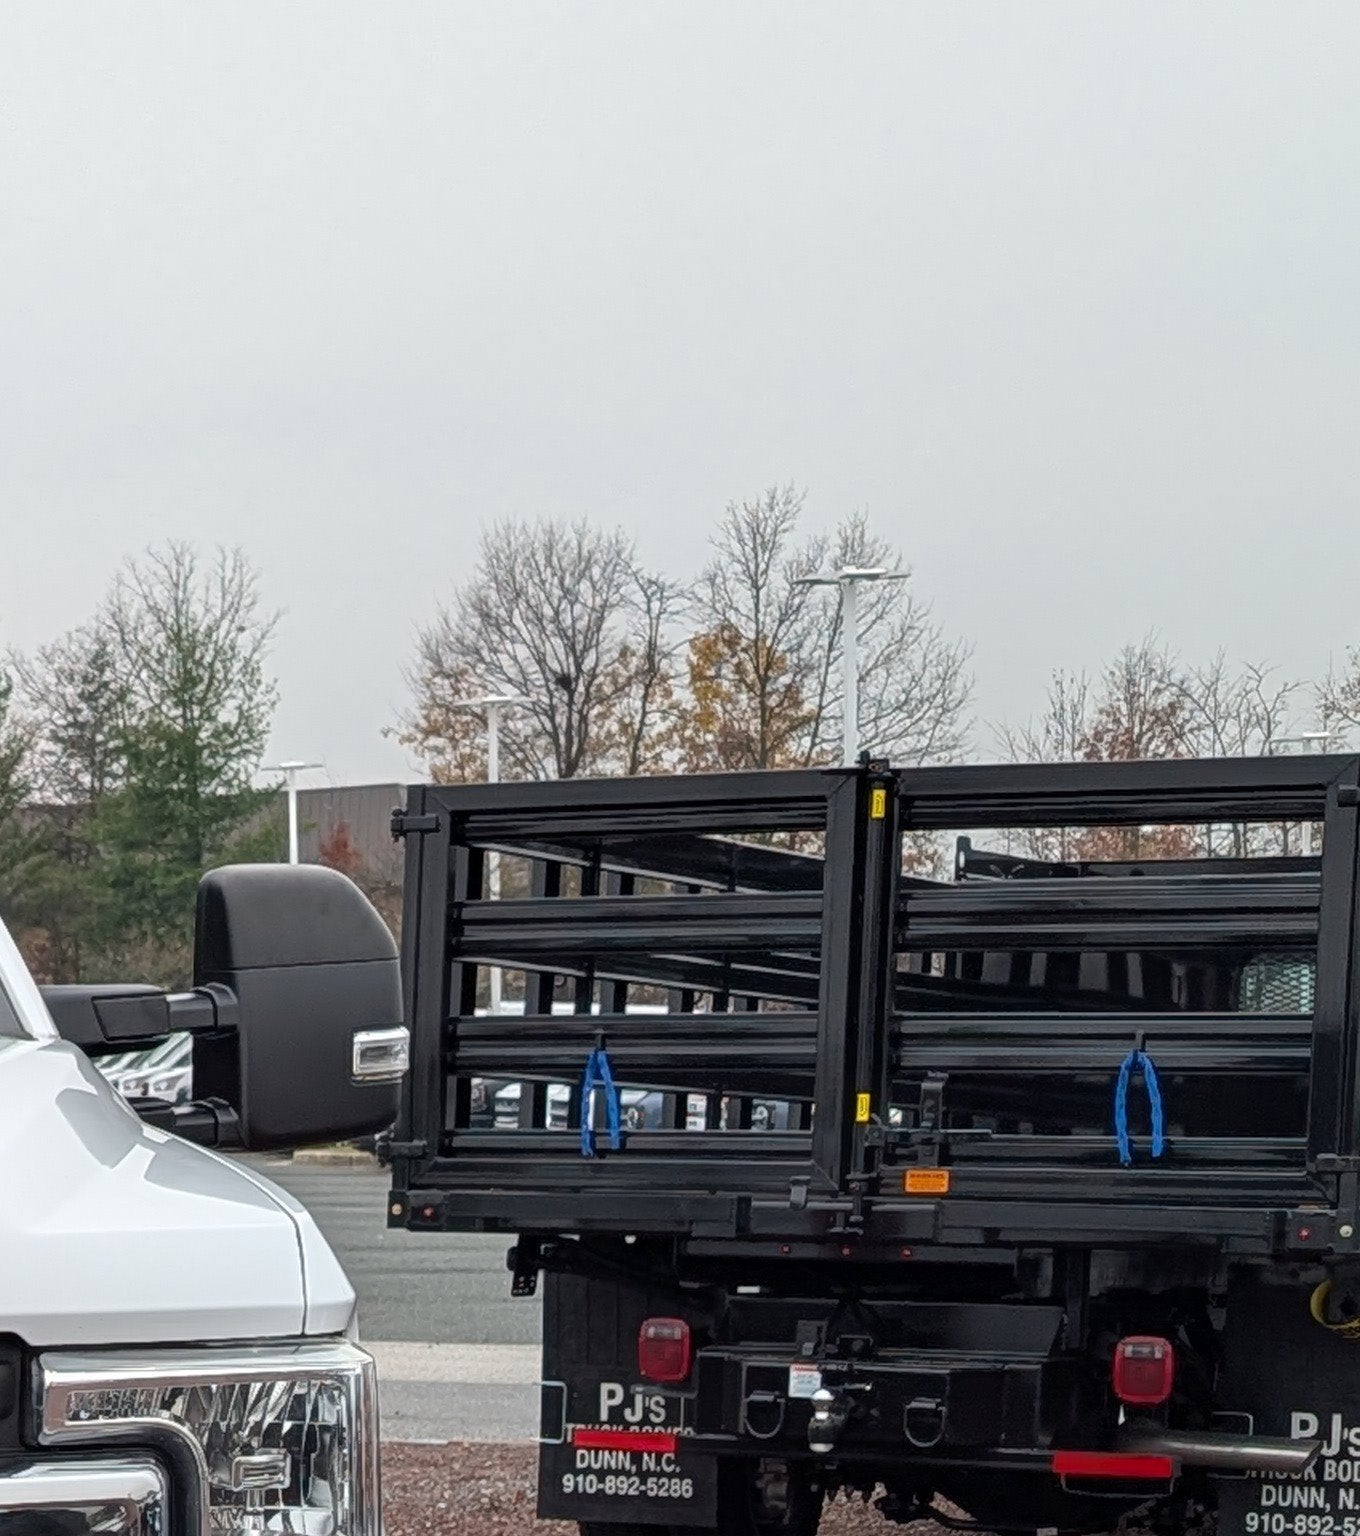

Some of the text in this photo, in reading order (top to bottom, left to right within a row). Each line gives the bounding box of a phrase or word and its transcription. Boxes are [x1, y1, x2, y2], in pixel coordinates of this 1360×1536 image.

[575, 1449, 681, 1474] DUNN, N.C.
[561, 1473, 694, 1499] 910-892-5286
[1260, 1484, 1331, 1513] DUNN,
